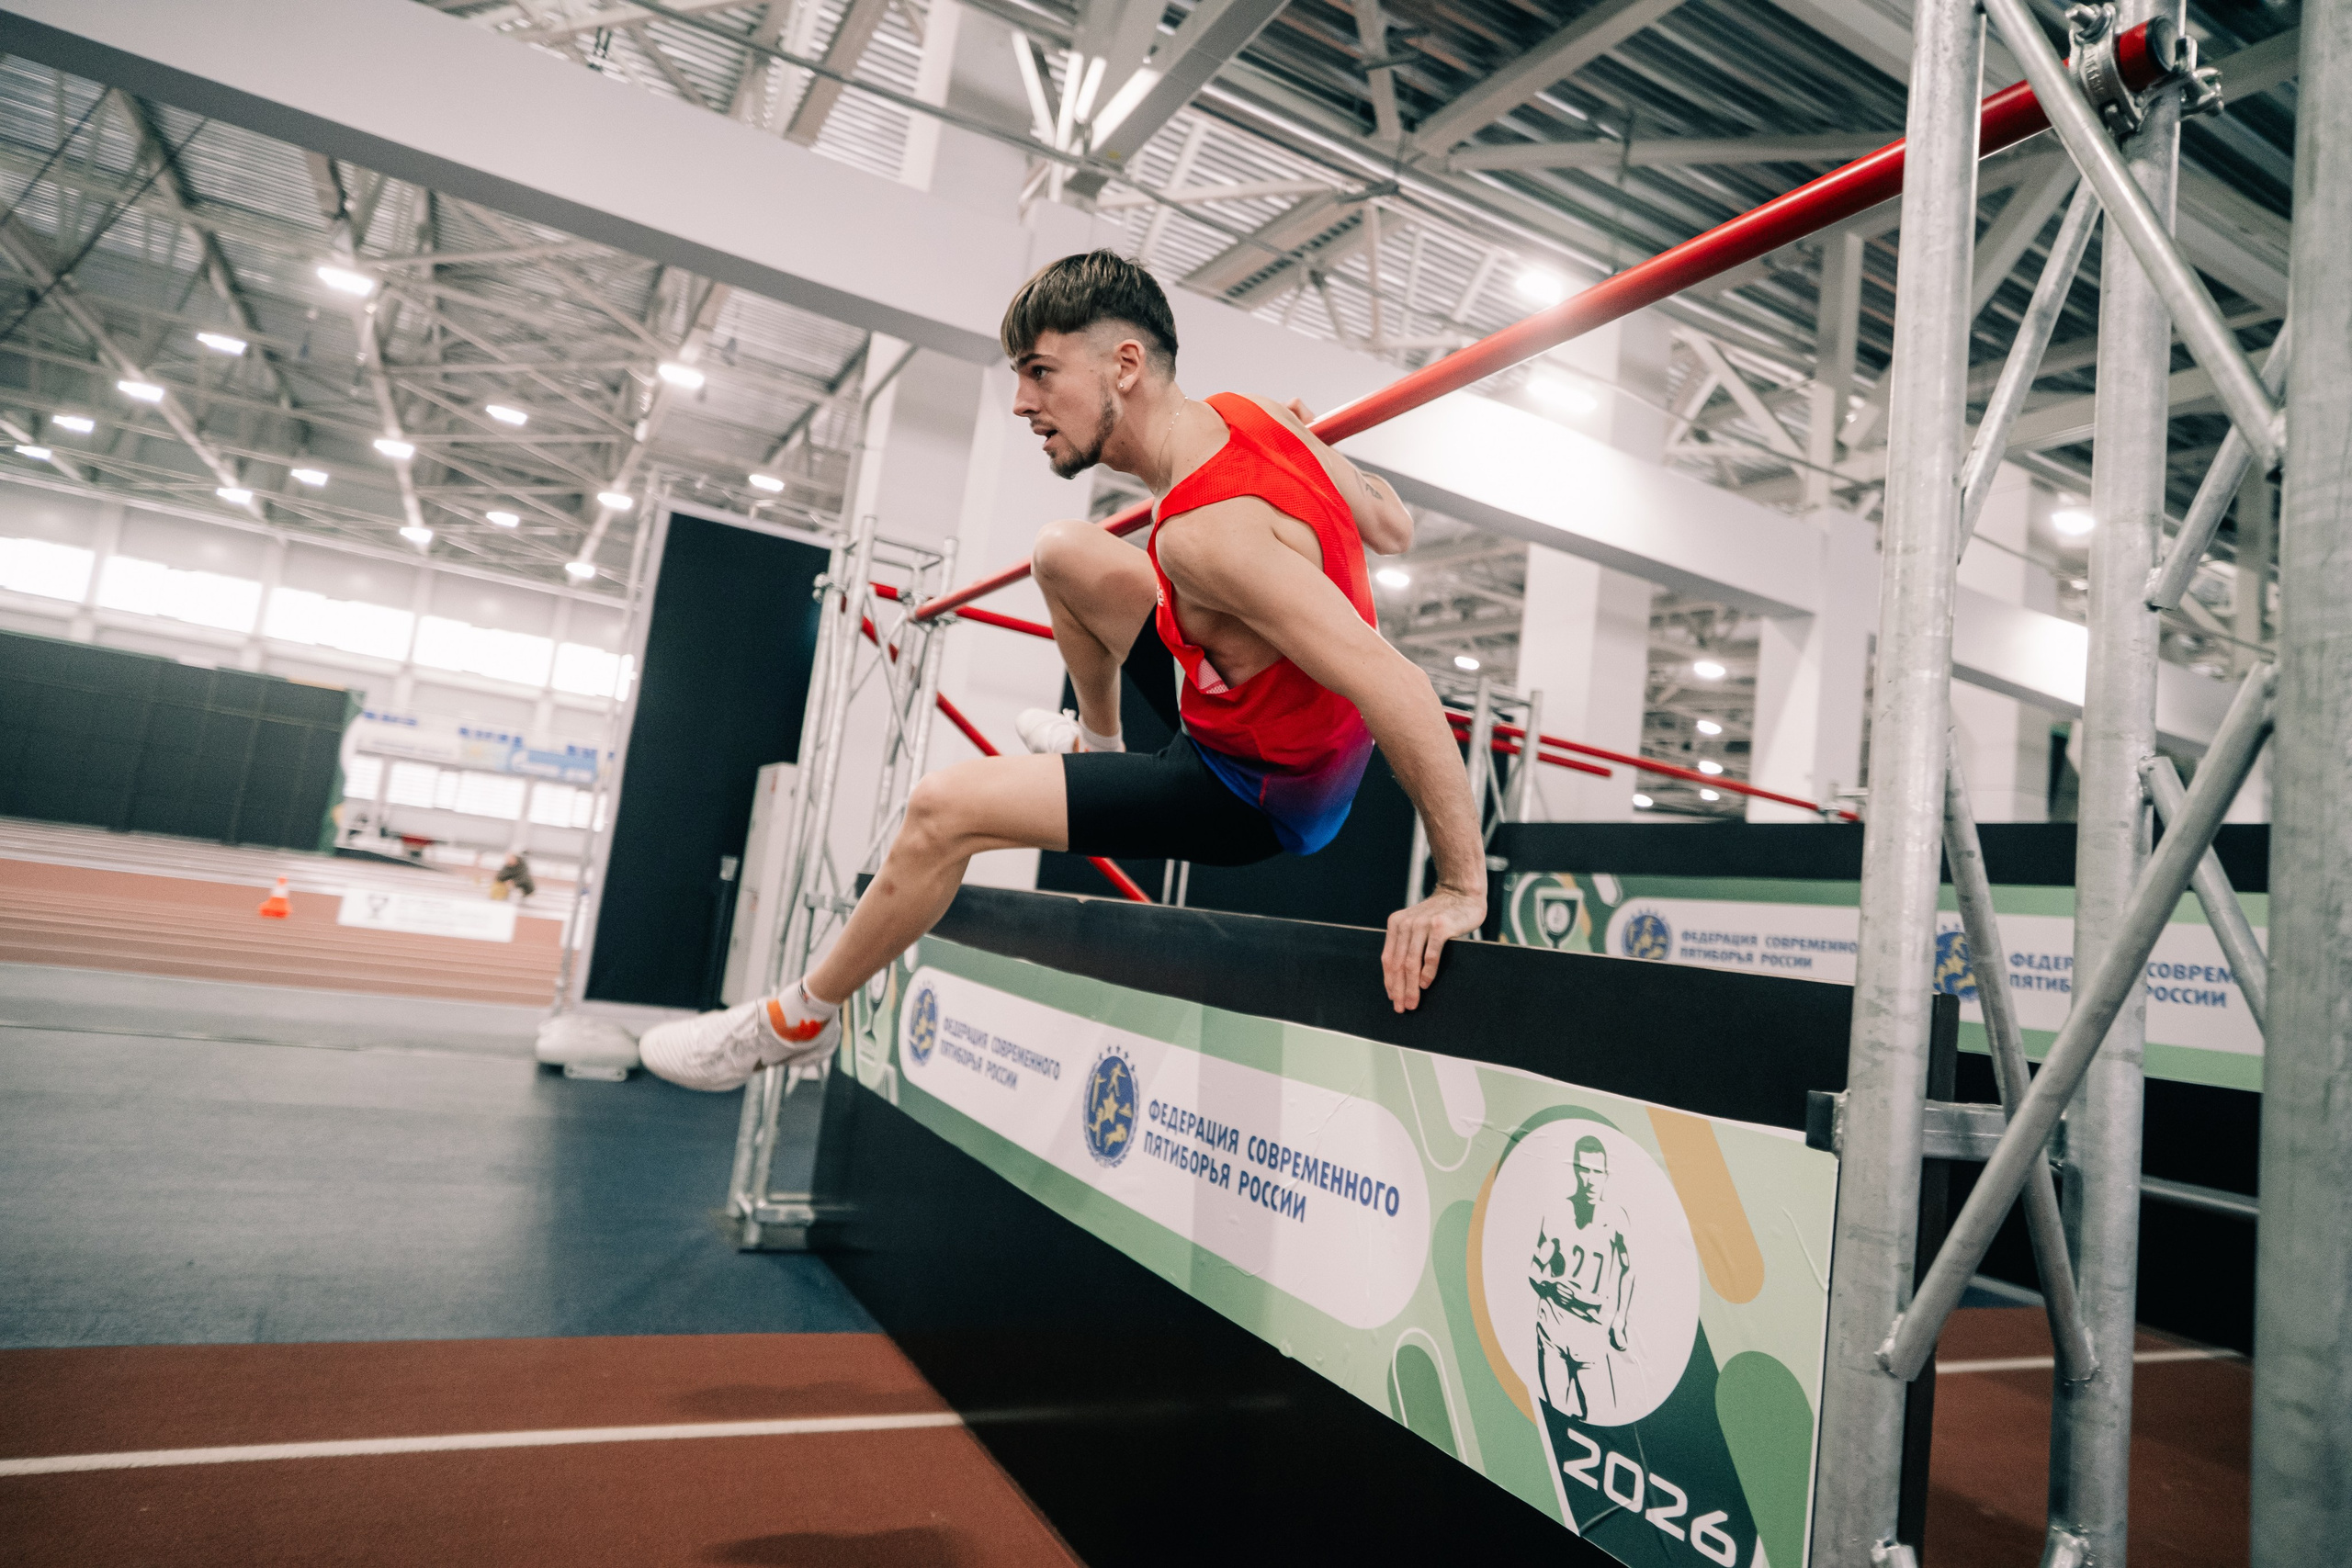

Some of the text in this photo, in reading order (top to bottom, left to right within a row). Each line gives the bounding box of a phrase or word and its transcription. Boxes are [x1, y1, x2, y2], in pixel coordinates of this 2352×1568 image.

[1680, 931, 1857, 953] ФЕДЕРАЦИЯ СОВРЕМЕННО
[1680, 947, 1812, 968] ПЯТИБОРЬЯ РОССИИ
[2009, 953, 2231, 983] ФЕДЕР СОВРЕМ
[2009, 974, 2071, 992] ПЯТИБ
[940, 1039, 1018, 1090] ПЯТИБОРЬЯ РОССИИ
[943, 1016, 1060, 1080] ФЕДЕРАЦИЯ СОВРЕМЕННОГО
[1144, 1130, 1306, 1223] ПЯТИБОРЬЯ РОССИИ
[1148, 1100, 1399, 1217] ФЕДЕРАЦИЯ СОВРЕМЕННОГО
[1564, 1427, 1736, 1568] 2026
